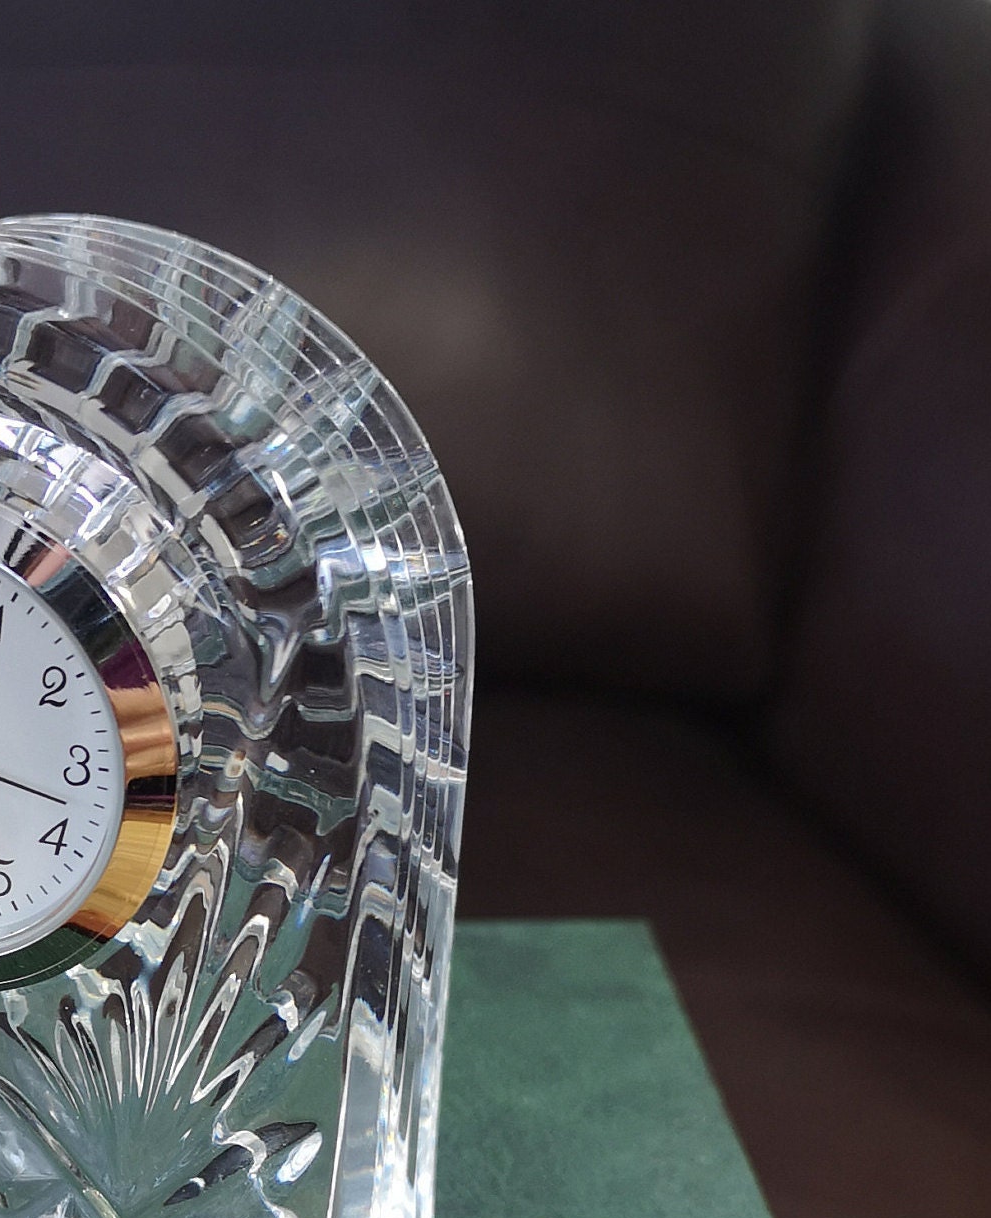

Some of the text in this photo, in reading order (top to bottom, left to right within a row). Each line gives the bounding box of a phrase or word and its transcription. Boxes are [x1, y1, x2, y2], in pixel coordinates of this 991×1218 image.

[39, 666, 67, 708] 2
[63, 746, 90, 787] 3
[39, 818, 68, 856] 4
